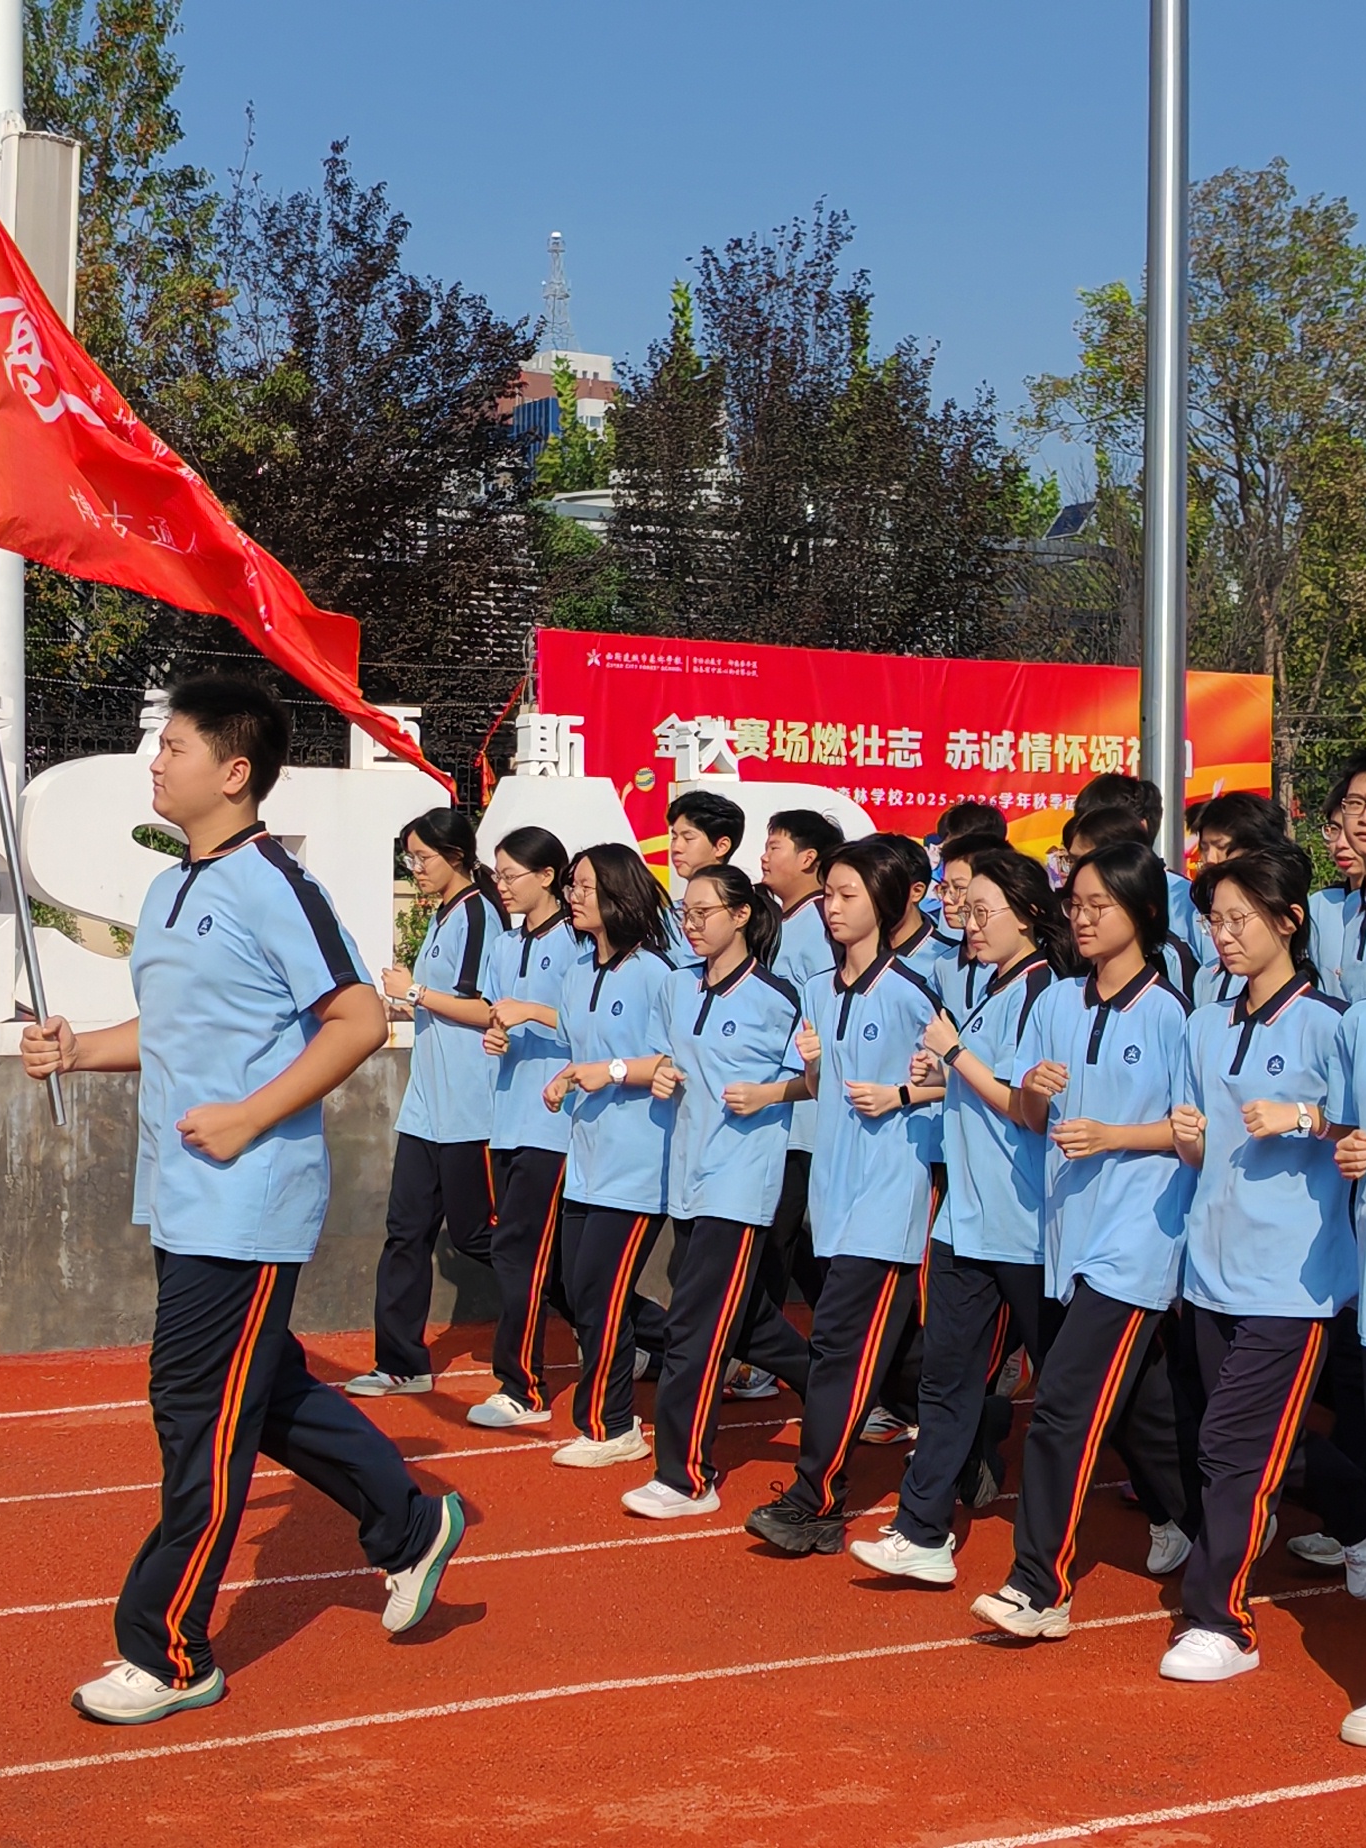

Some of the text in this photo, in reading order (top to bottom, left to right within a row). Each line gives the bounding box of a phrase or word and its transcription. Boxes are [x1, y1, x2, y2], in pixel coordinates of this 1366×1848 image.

[945, 728, 1193, 778] 赤诚情怀颂
